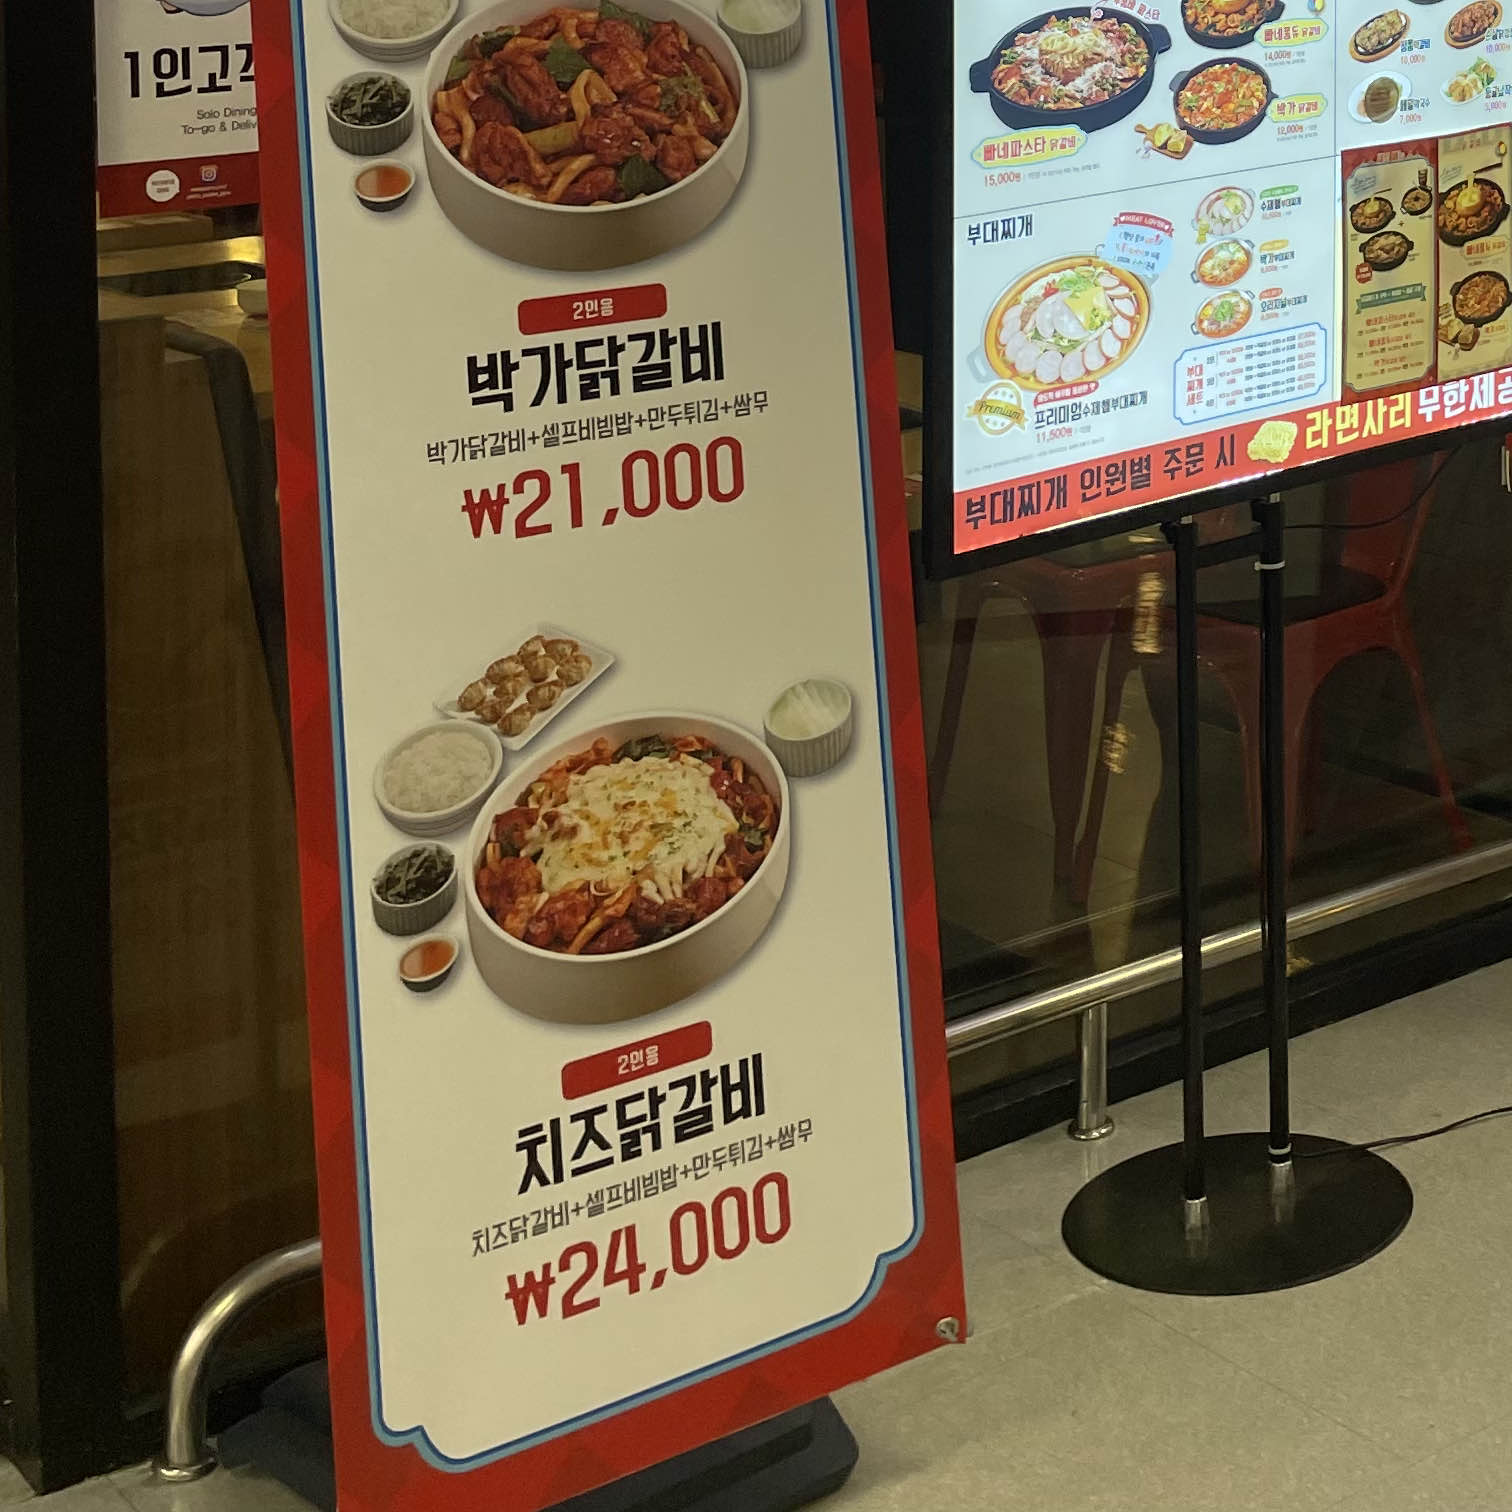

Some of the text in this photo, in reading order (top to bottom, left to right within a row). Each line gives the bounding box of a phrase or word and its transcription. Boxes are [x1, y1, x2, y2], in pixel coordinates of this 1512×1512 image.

[196, 105, 257, 120] Solo Dining
[966, 213, 1034, 247] 부대찌개
[572, 297, 614, 321] 2인용
[465, 320, 727, 414] 박가닭갈비
[978, 401, 1022, 420] Premium
[461, 435, 746, 540] ₩21,000
[964, 473, 1068, 531] 부대찌개
[1079, 453, 1152, 503] 인원별
[1162, 441, 1205, 481] 주문
[1214, 433, 1236, 470] 시
[1304, 392, 1413, 451] 라면사리
[616, 1044, 660, 1076] 2인용
[515, 1052, 767, 1196] 치즈닭갈비
[504, 1170, 793, 1327] ₩24,000
